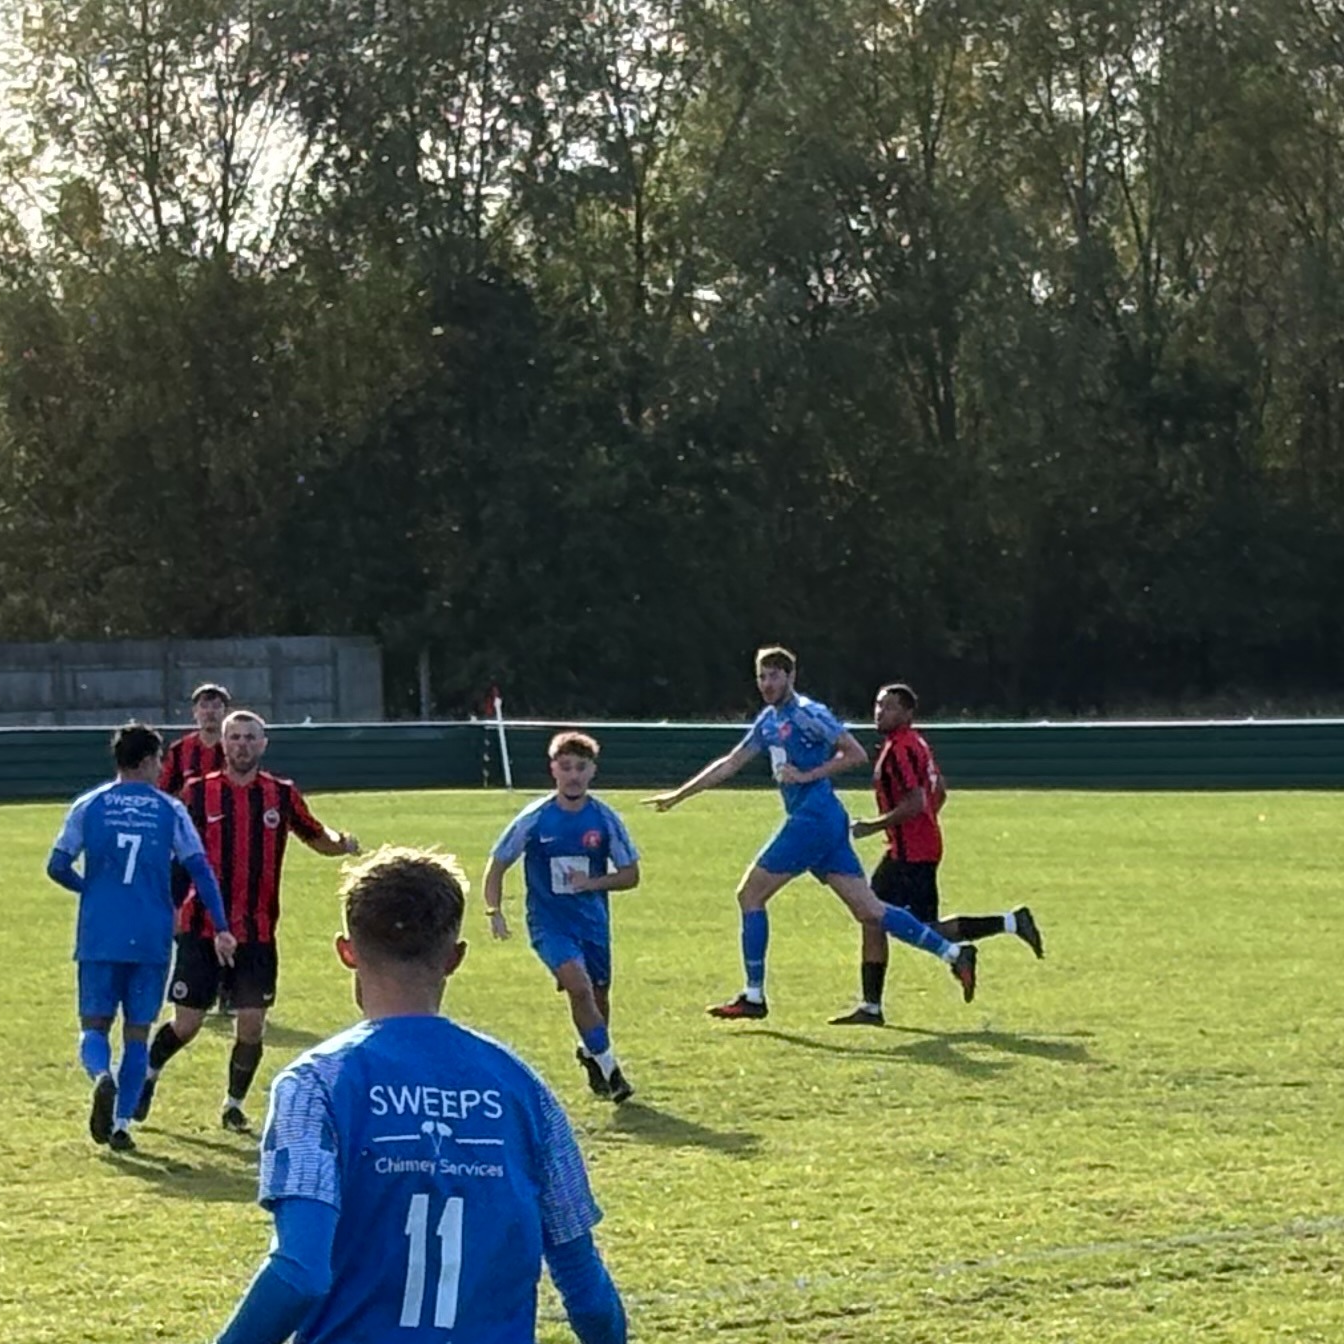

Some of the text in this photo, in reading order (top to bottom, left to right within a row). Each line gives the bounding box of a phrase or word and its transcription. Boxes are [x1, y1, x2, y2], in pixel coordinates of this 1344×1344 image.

[117, 832, 142, 885] 7
[369, 1085, 503, 1119] SWEEPS
[375, 1157, 504, 1178] Chimney Services
[399, 1194, 464, 1329] 11
